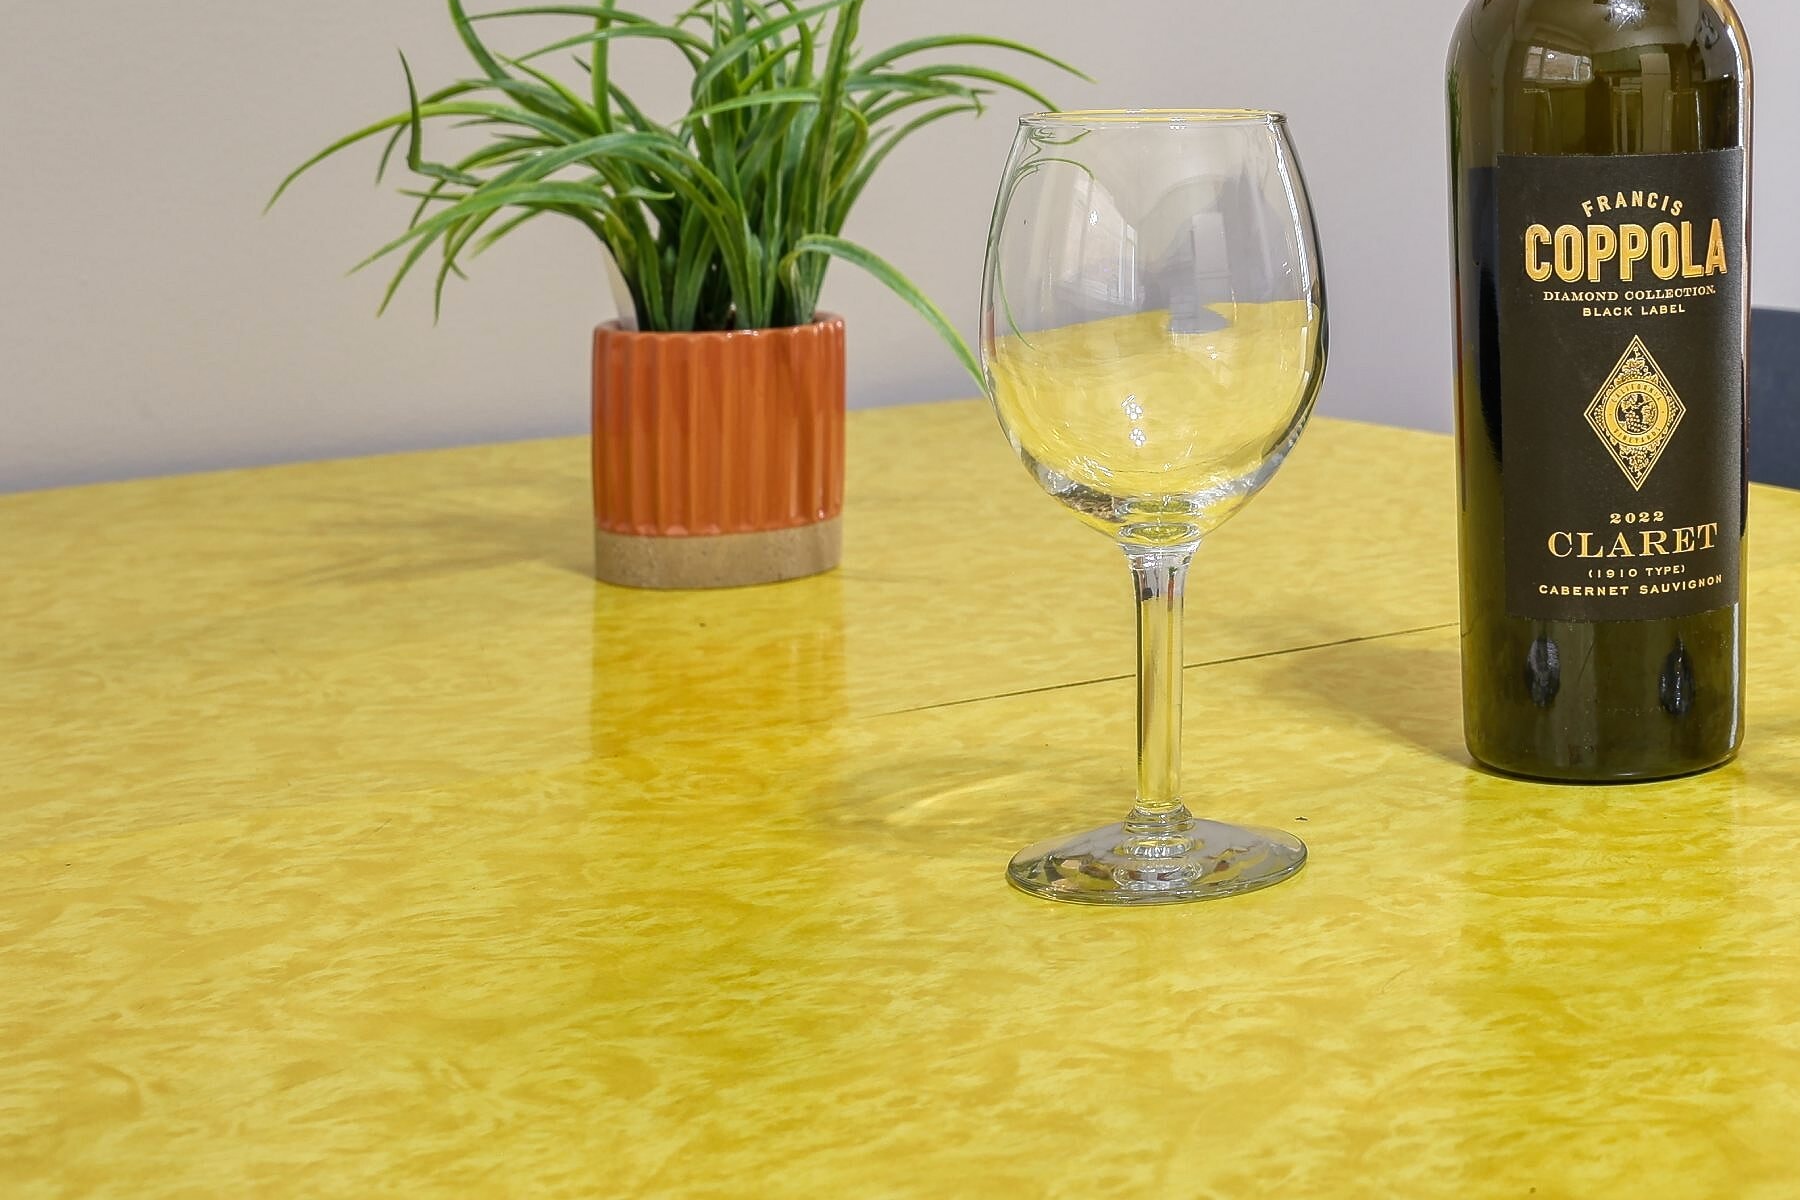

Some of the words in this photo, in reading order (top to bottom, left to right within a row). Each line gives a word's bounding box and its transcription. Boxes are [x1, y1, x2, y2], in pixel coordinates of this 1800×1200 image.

[1581, 190, 1684, 218] FRANCIS
[1524, 218, 1728, 283] COPPOLA
[1543, 291, 1619, 302] DIAMOND
[1582, 306, 1633, 318] BLACK
[1641, 303, 1686, 316] LABEL
[1609, 510, 1665, 525] 2022
[1547, 522, 1718, 559] CLARET
[1588, 568, 1638, 579] (1910
[1645, 564, 1686, 577] TYPE)
[1538, 584, 1630, 597] CABERNET
[1639, 573, 1723, 595] SAUVIGNON
